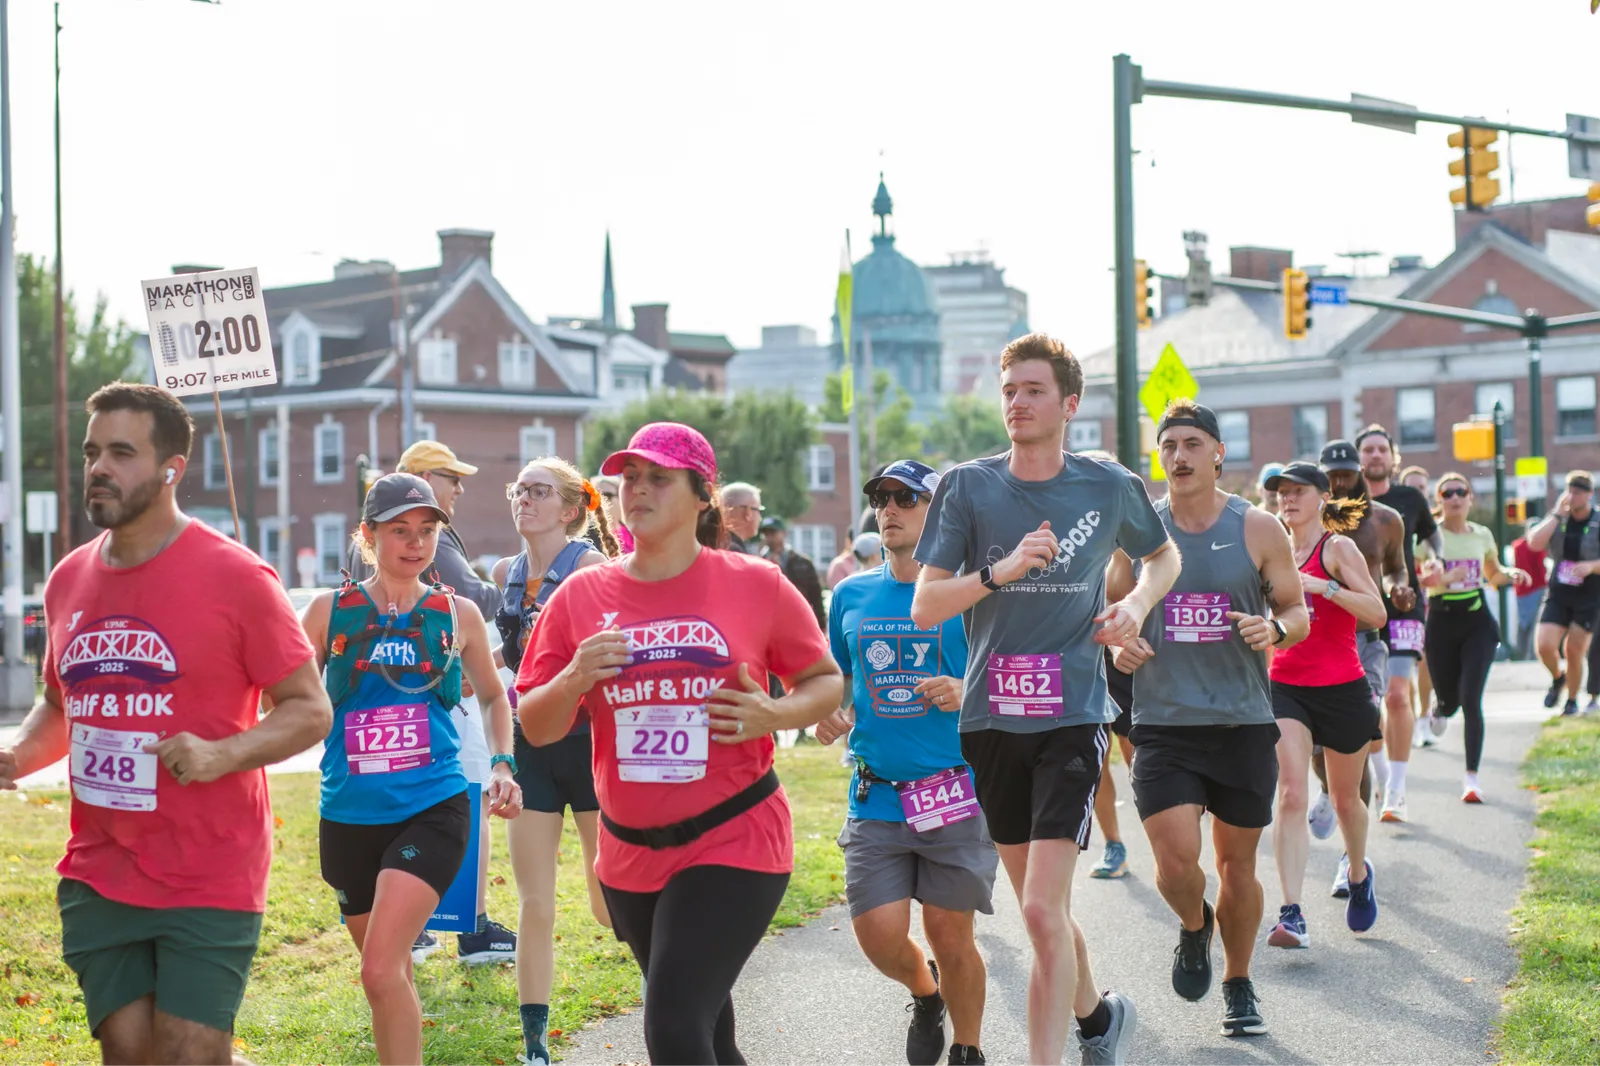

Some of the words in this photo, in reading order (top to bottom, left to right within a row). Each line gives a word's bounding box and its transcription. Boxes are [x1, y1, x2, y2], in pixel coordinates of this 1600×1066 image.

[147, 276, 242, 299] MARATHON
[148, 289, 244, 311] PACING
[195, 314, 261, 358] 2:00
[166, 372, 207, 389] 9:07
[214, 373, 239, 384] PER
[242, 369, 271, 381] MILE
[1001, 586, 1037, 594] CLEARED
[104, 620, 129, 629] UPMC
[1172, 607, 1223, 625] 1302
[862, 624, 884, 632] YMCA
[648, 648, 677, 660] 2025
[98, 662, 124, 673] 2025
[875, 675, 924, 686] MARATHO
[995, 673, 1052, 696] 1462
[603, 680, 655, 704] Half
[659, 678, 679, 700] &
[890, 691, 910, 699] 2023
[64, 694, 100, 718] Half
[101, 693, 120, 717] &
[125, 693, 174, 717] 10K
[878, 705, 924, 713] HALF-MARATHON
[355, 725, 418, 752] 1225
[631, 729, 689, 756] 220
[83, 750, 135, 783] 248
[909, 780, 964, 813] 1544
[490, 942, 513, 950] HOKA
